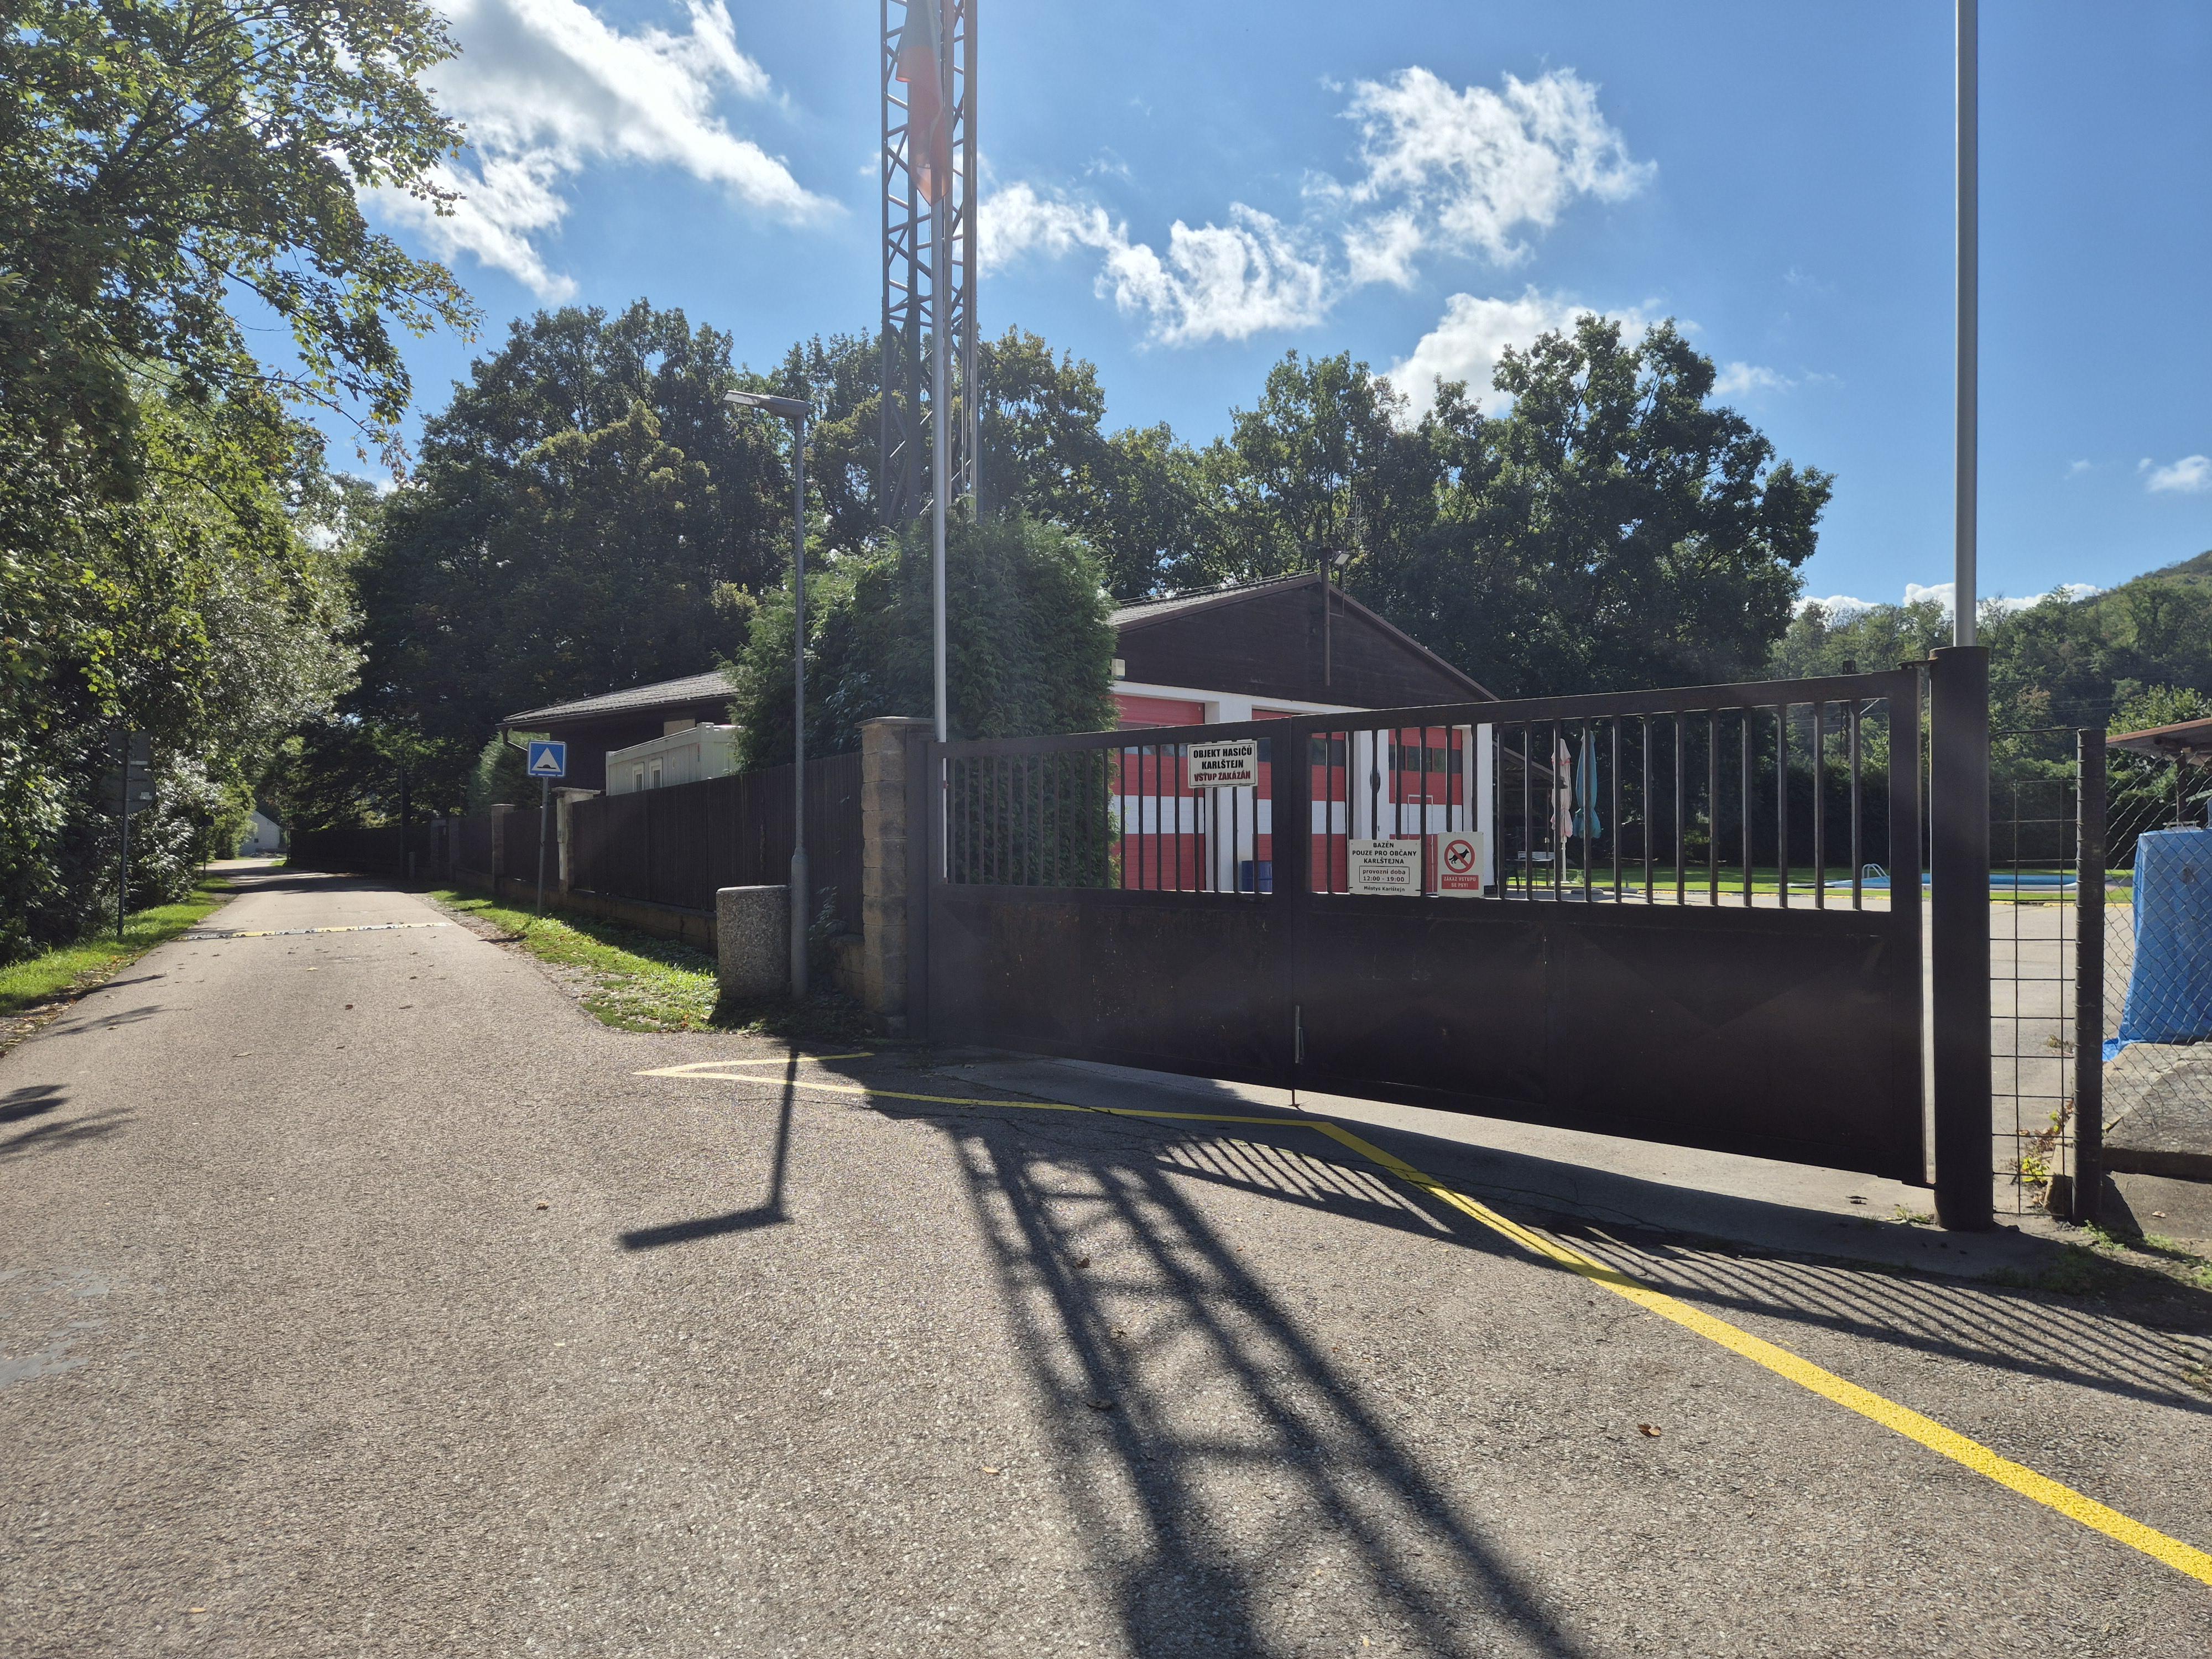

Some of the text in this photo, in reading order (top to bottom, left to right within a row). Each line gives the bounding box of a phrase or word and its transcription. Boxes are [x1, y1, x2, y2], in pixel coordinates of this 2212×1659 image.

[1193, 745, 1252, 758] OBJEKT HASIČŮ
[1202, 759, 1243, 769] KARLŠTEJN
[1194, 770, 1250, 781] VSTUP ZAKÁZÁN
